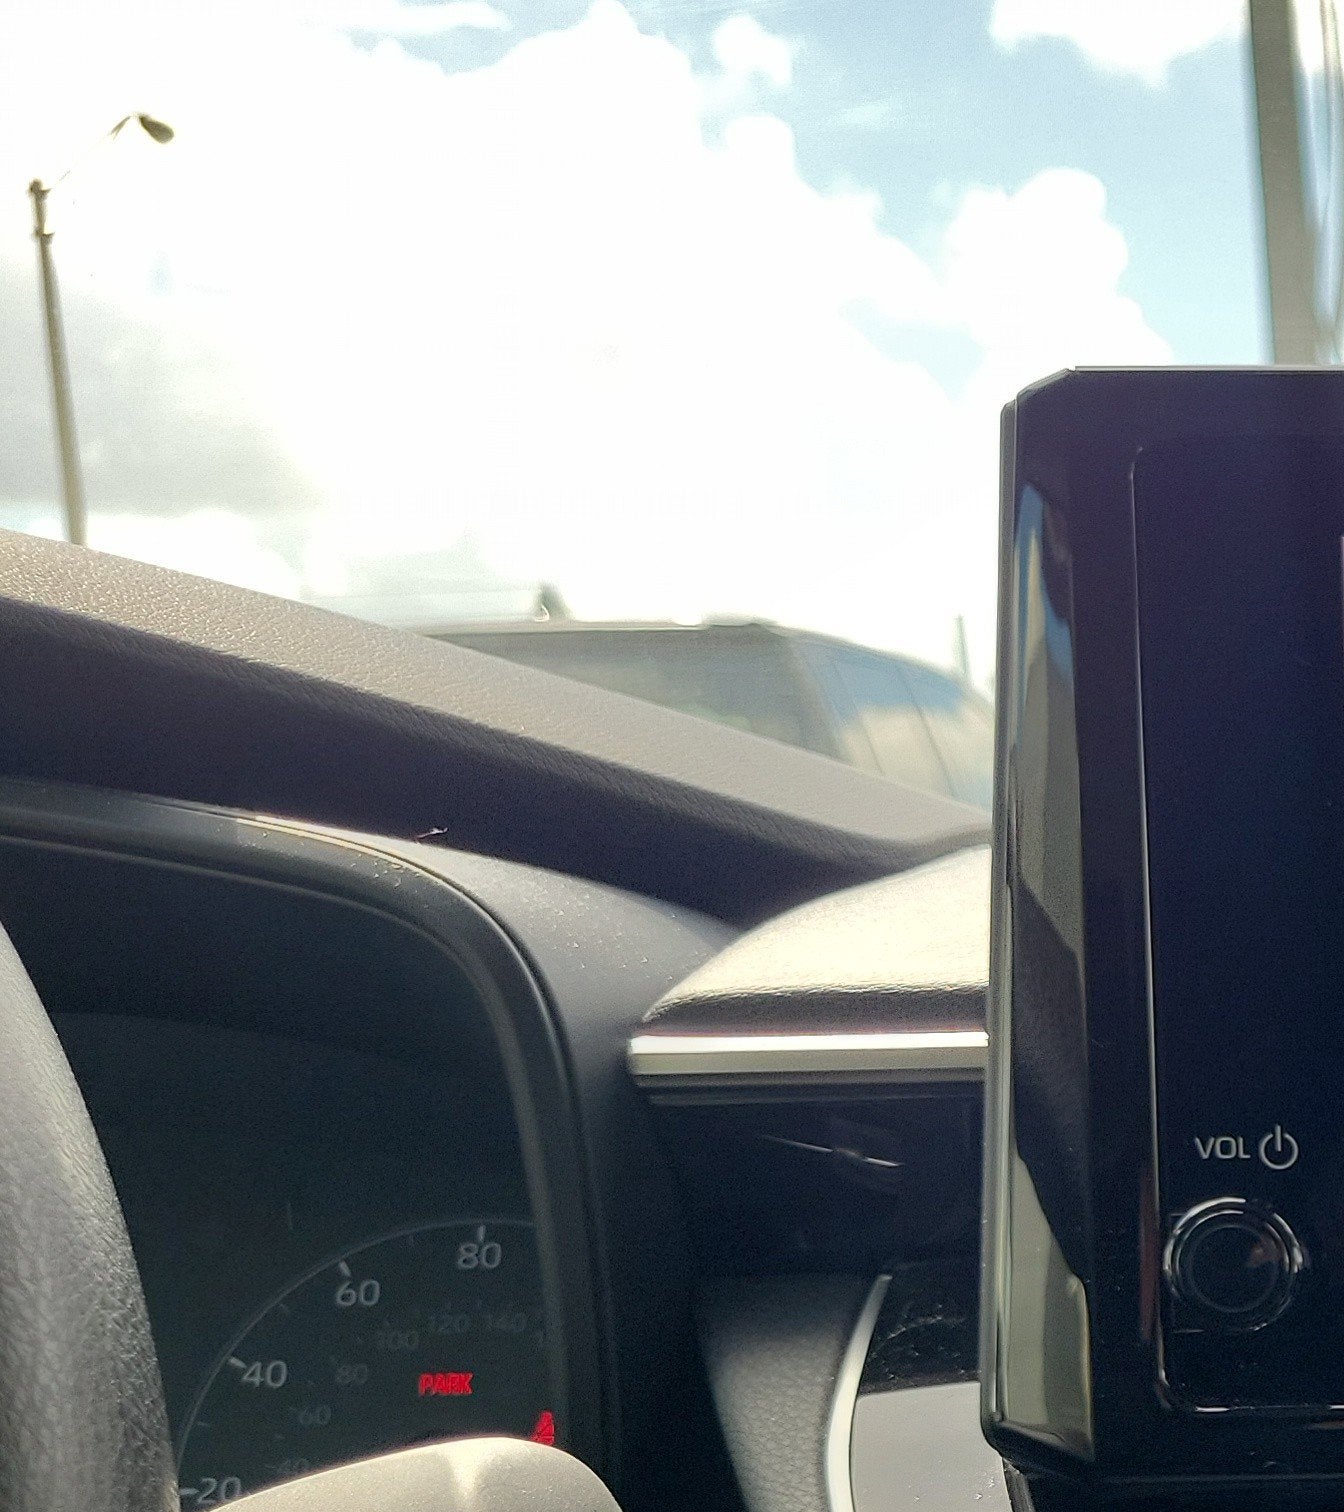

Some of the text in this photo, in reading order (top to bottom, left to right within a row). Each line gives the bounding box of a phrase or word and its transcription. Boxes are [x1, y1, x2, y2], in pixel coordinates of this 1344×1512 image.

[1194, 1136, 1251, 1160] VOL
[457, 1242, 502, 1270] 80
[335, 1279, 381, 1307] 60
[241, 1360, 288, 1389] 40
[419, 1372, 474, 1396] PARK
[195, 1476, 243, 1505] 20
